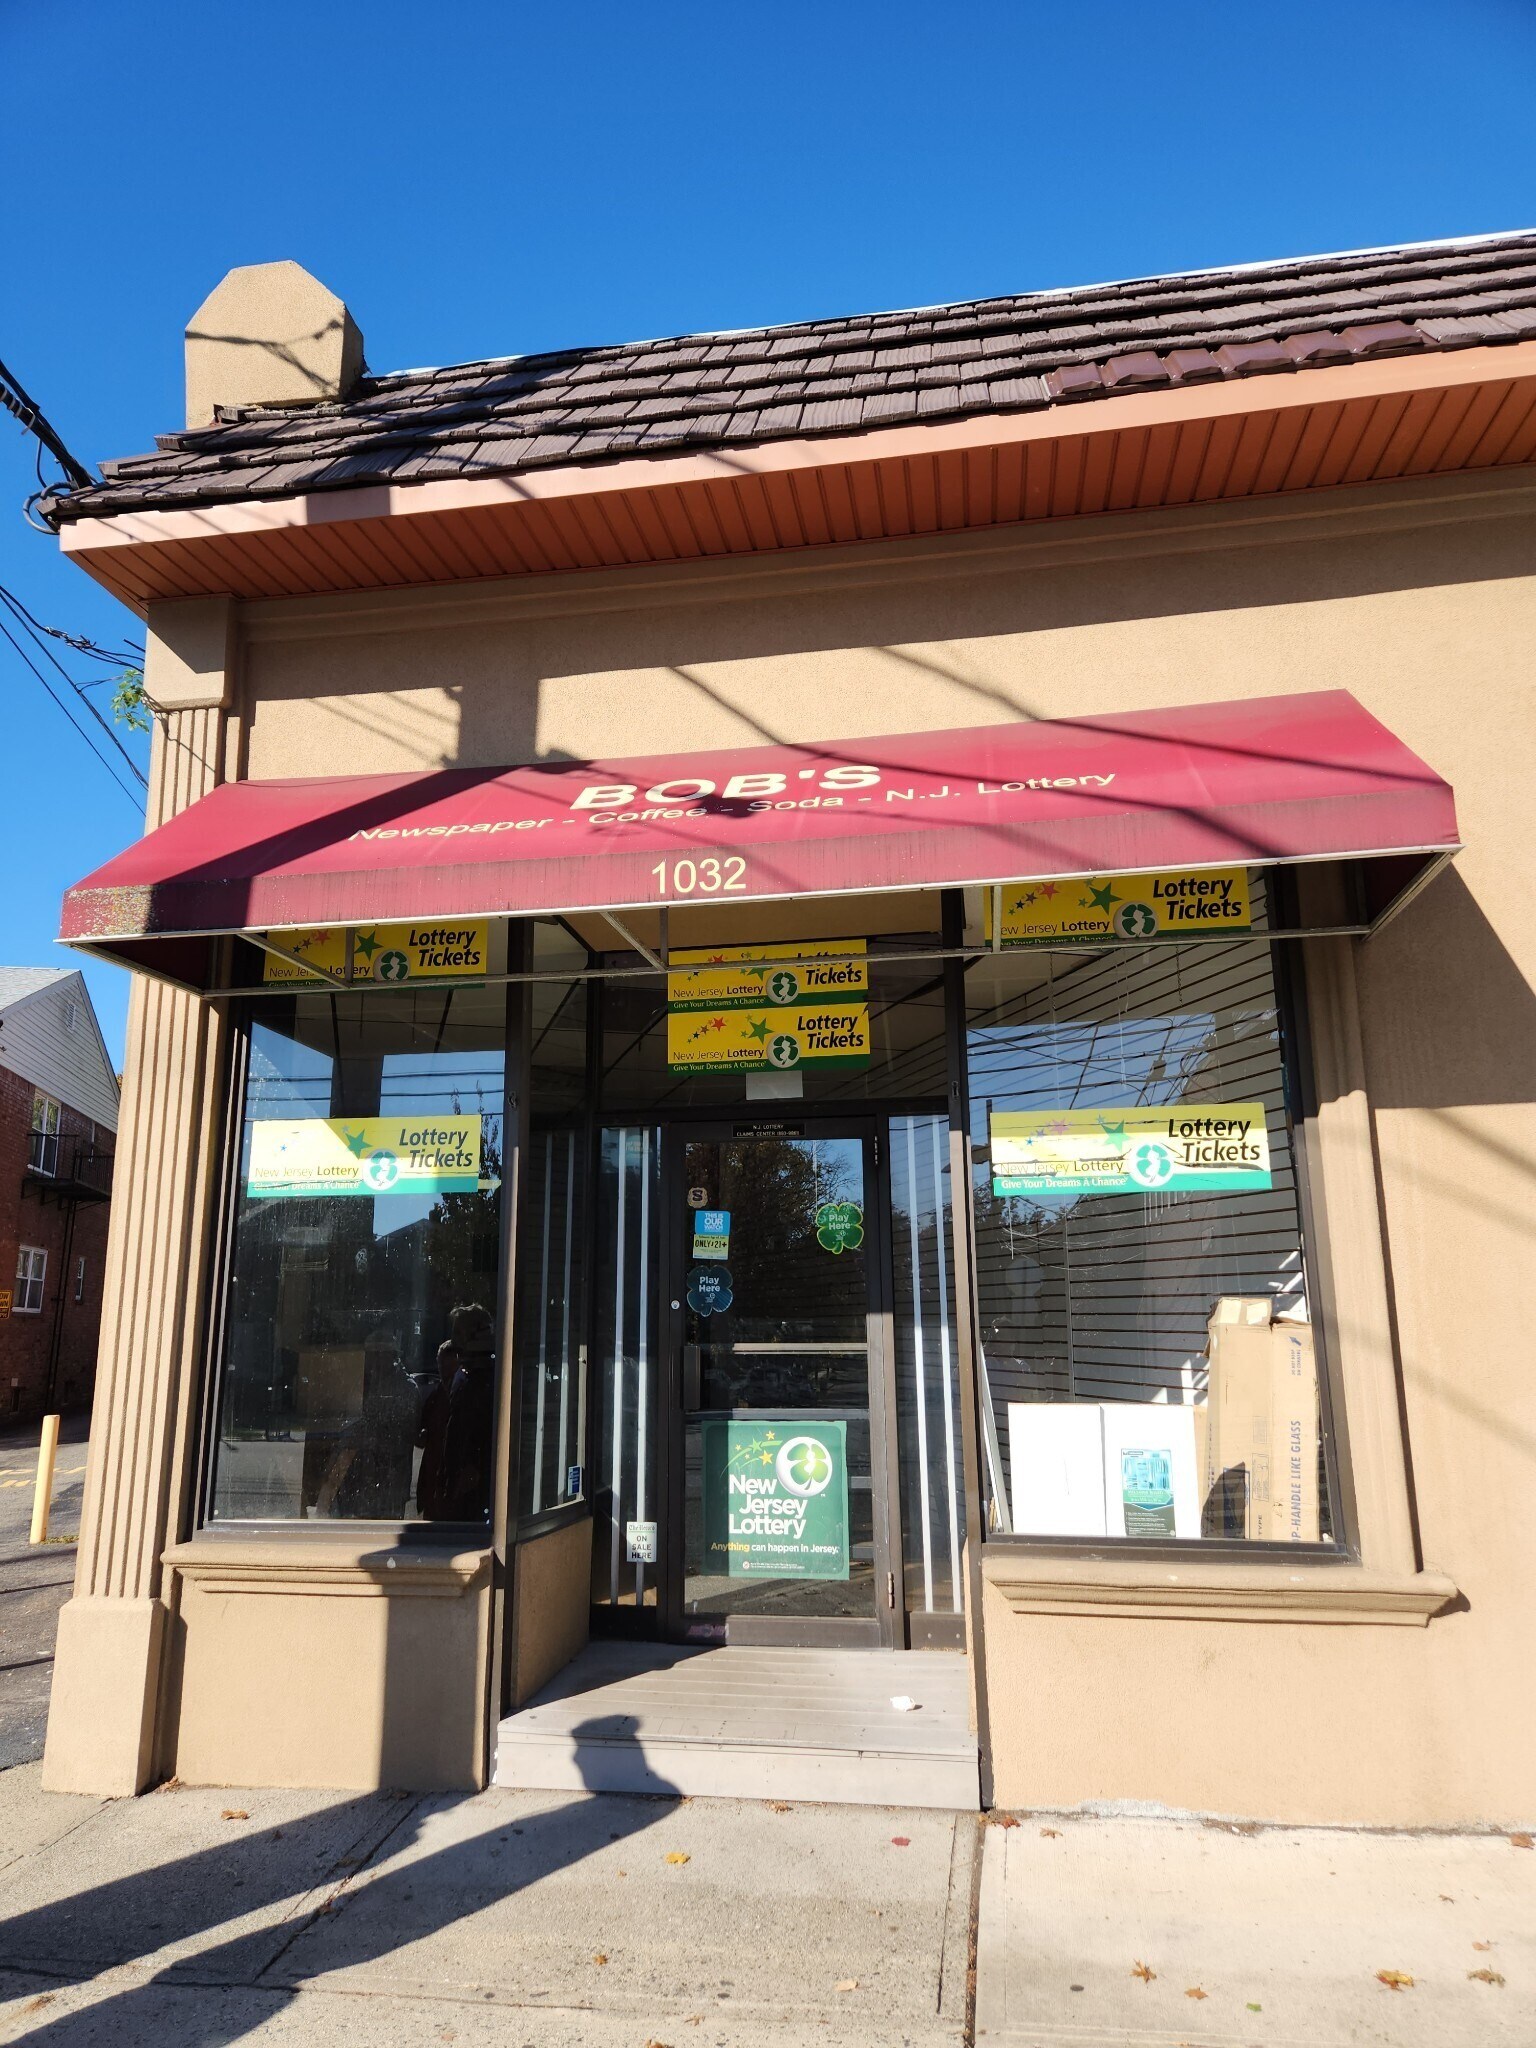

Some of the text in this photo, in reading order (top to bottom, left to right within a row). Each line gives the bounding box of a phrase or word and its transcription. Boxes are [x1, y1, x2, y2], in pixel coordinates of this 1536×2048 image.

[570, 765, 881, 810] BOB'S
[349, 817, 553, 841] Newspaper
[589, 807, 707, 823] Coffee
[748, 796, 844, 813] Soda
[885, 786, 961, 802] N.J.
[978, 772, 1116, 795] Lottery
[652, 857, 747, 894] 1032
[1153, 878, 1234, 899] Lottery
[1166, 898, 1242, 920] Tickets
[1001, 921, 1110, 935] ew Jersey Lottery
[409, 929, 477, 948] Lottery
[418, 947, 480, 967] Tickets
[270, 968, 293, 977] New
[330, 965, 370, 977] Loery
[806, 967, 862, 985] Tickets
[674, 986, 763, 997] New Jersey Lottery
[798, 1014, 858, 1032] Lottery
[807, 1031, 864, 1049] Tickets
[674, 1049, 764, 1060] New Jersey Lottery
[400, 1128, 468, 1149] Lottery
[1168, 1118, 1251, 1141] Lottery
[409, 1149, 473, 1168] Tickets
[1182, 1141, 1260, 1162] Tickets
[255, 1168, 279, 1177] New
[317, 1166, 359, 1177] Lottery
[1001, 1161, 1124, 1173] New Jersey Lottery
[1001, 1180, 1021, 1188] Give
[1023, 1179, 1043, 1188] Your
[1046, 1178, 1080, 1187] Dreams
[1083, 1178, 1090, 1186] A
[829, 1214, 849, 1222] Play
[829, 1222, 850, 1230] Here
[700, 1276, 719, 1284] Play
[1291, 1420, 1301, 1453] GLASS
[1291, 1457, 1301, 1479] LIKE
[729, 1474, 777, 1494] New
[739, 1494, 808, 1518] Jersey
[729, 1514, 807, 1539] Lottery
[711, 1542, 750, 1552] Anything
[751, 1544, 766, 1552] can
[768, 1543, 799, 1553] happen
[801, 1544, 808, 1552] in
